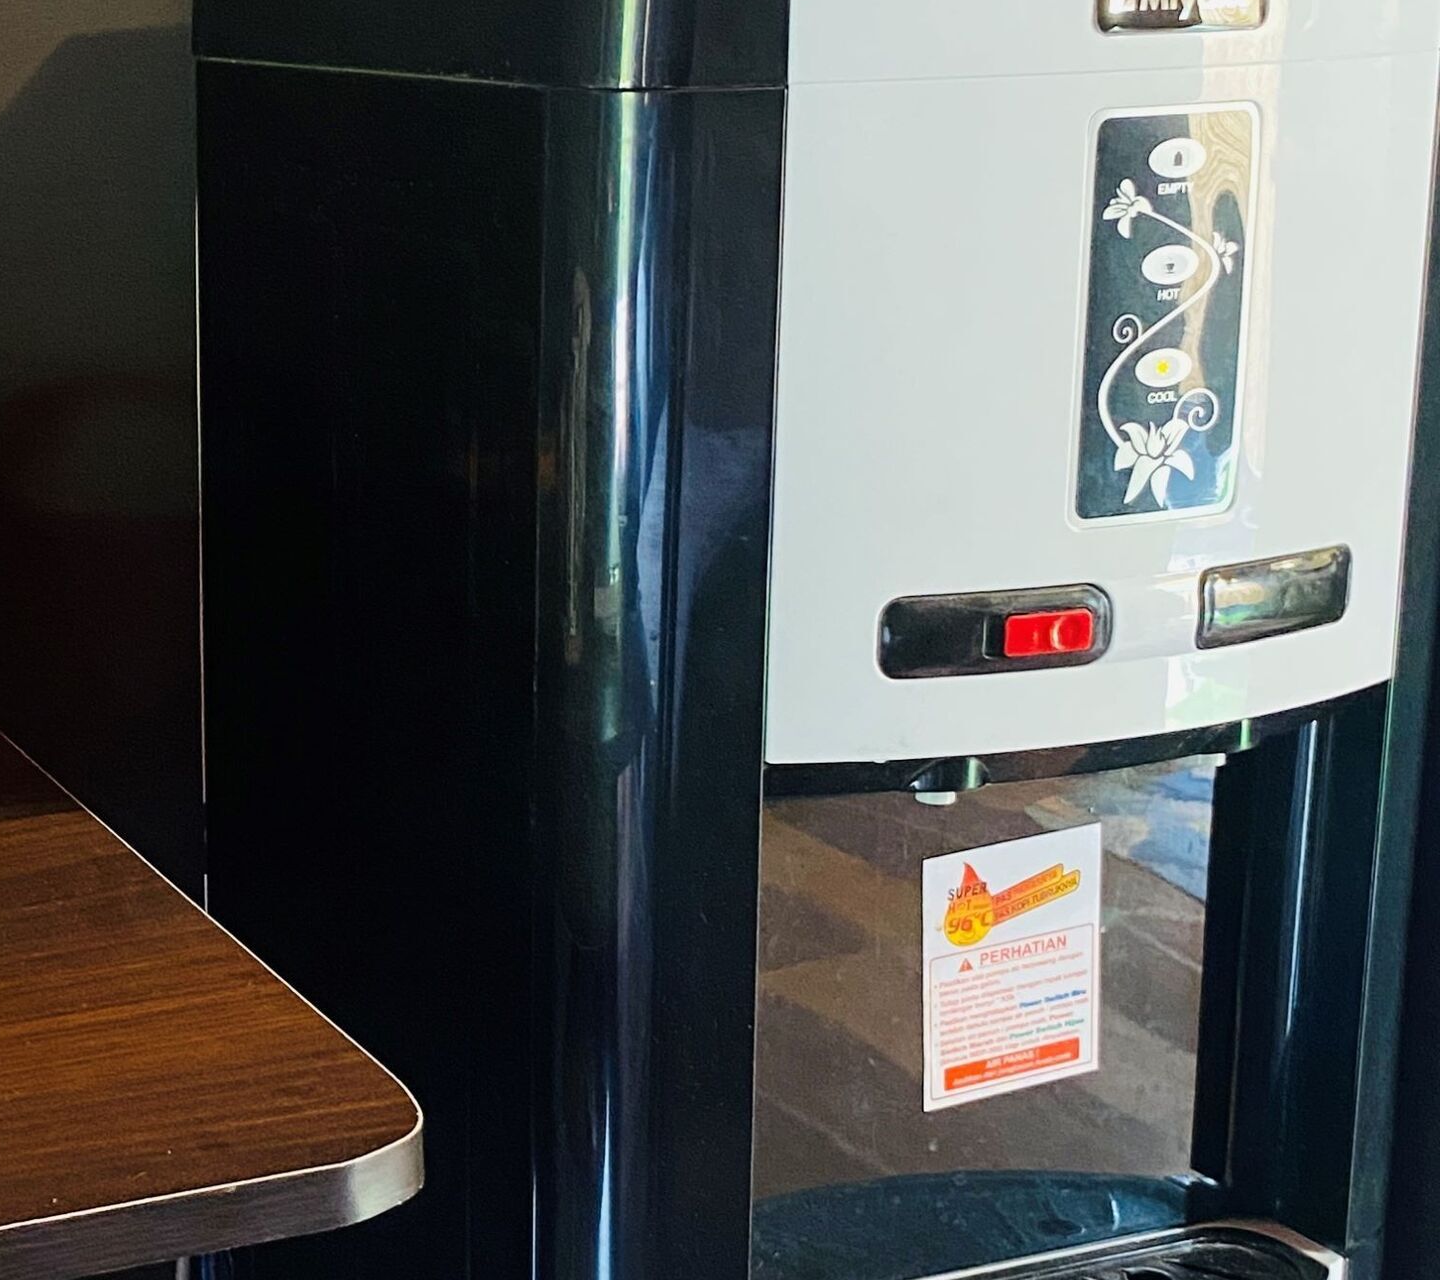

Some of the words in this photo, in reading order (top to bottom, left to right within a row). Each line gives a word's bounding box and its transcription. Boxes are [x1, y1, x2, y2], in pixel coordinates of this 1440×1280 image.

[1156, 288, 1181, 301] HOT
[1147, 390, 1178, 405] COOL
[948, 882, 987, 901] SUPER
[948, 899, 971, 913] HOT
[980, 935, 1067, 965] PERHATIAN
